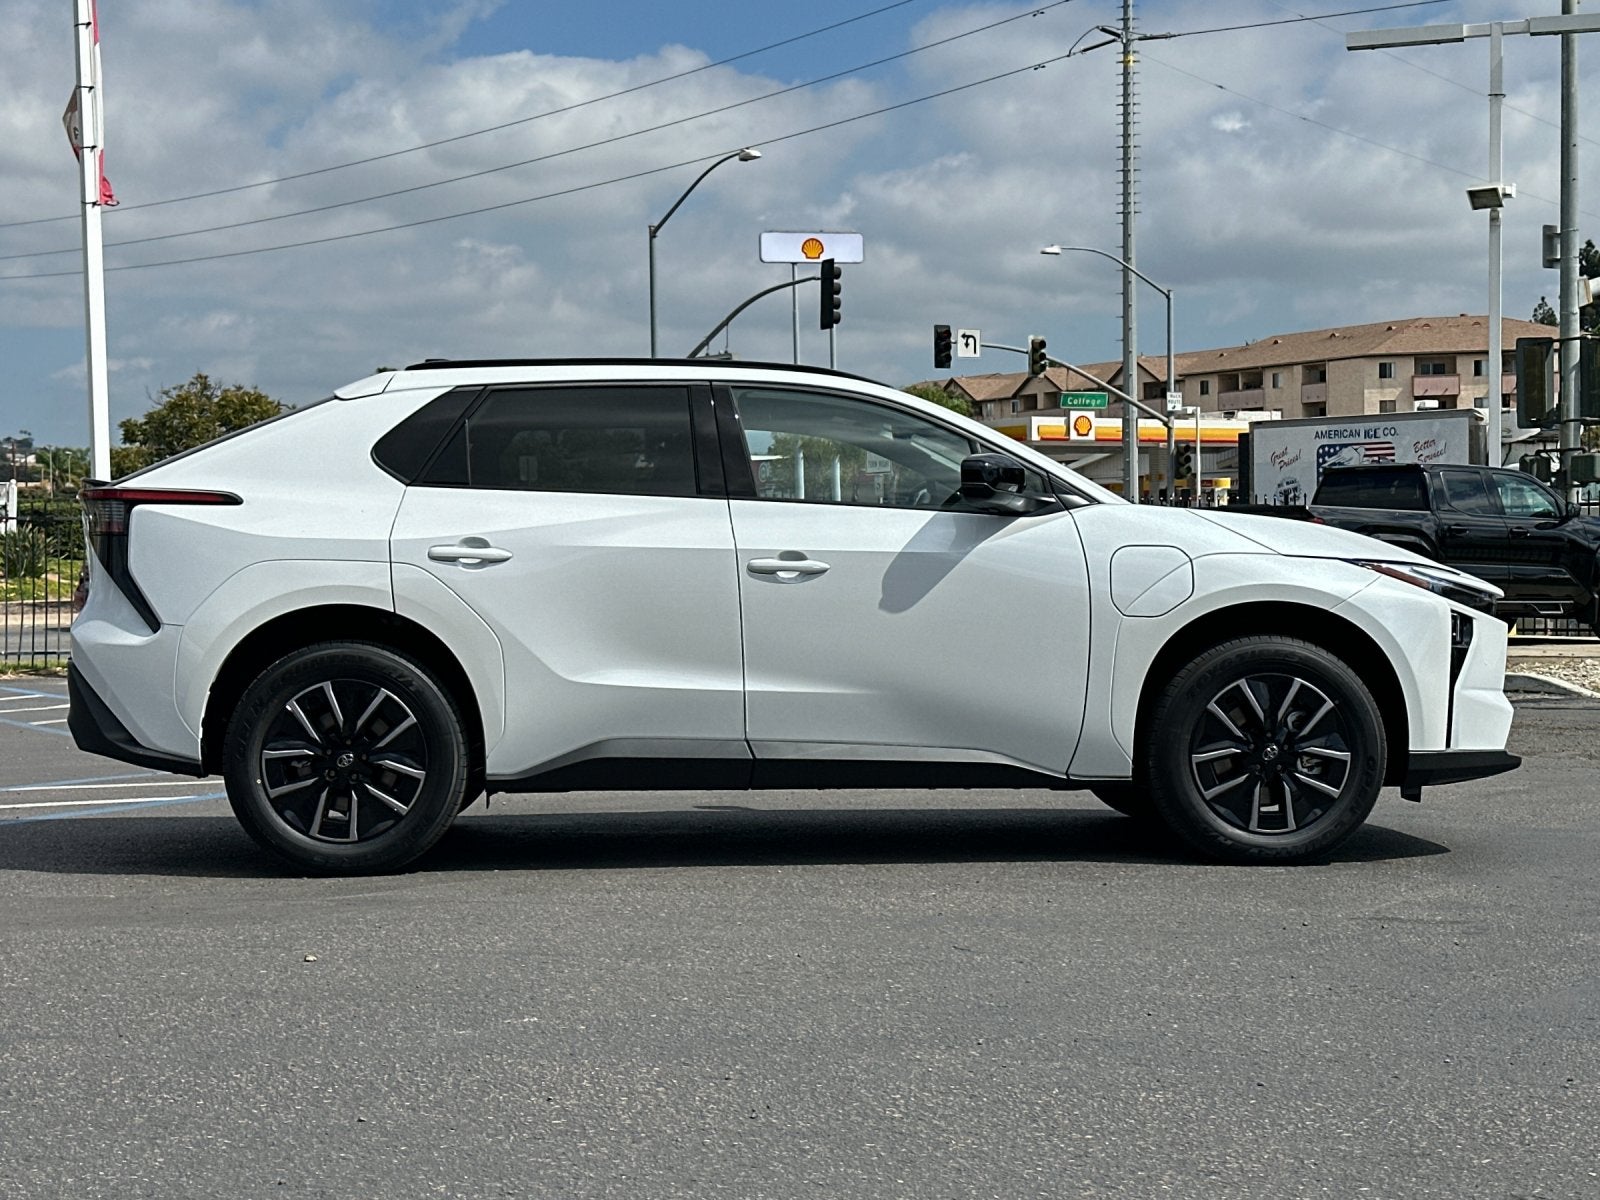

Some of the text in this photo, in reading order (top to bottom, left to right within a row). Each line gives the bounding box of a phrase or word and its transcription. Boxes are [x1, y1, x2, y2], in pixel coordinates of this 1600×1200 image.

[1067, 396, 1101, 407] College
[1314, 427, 1399, 440] AMERICAN ICE CO.
[1412, 438, 1436, 453] Better
[1270, 446, 1288, 467] Great
[1278, 448, 1302, 472] Prices!
